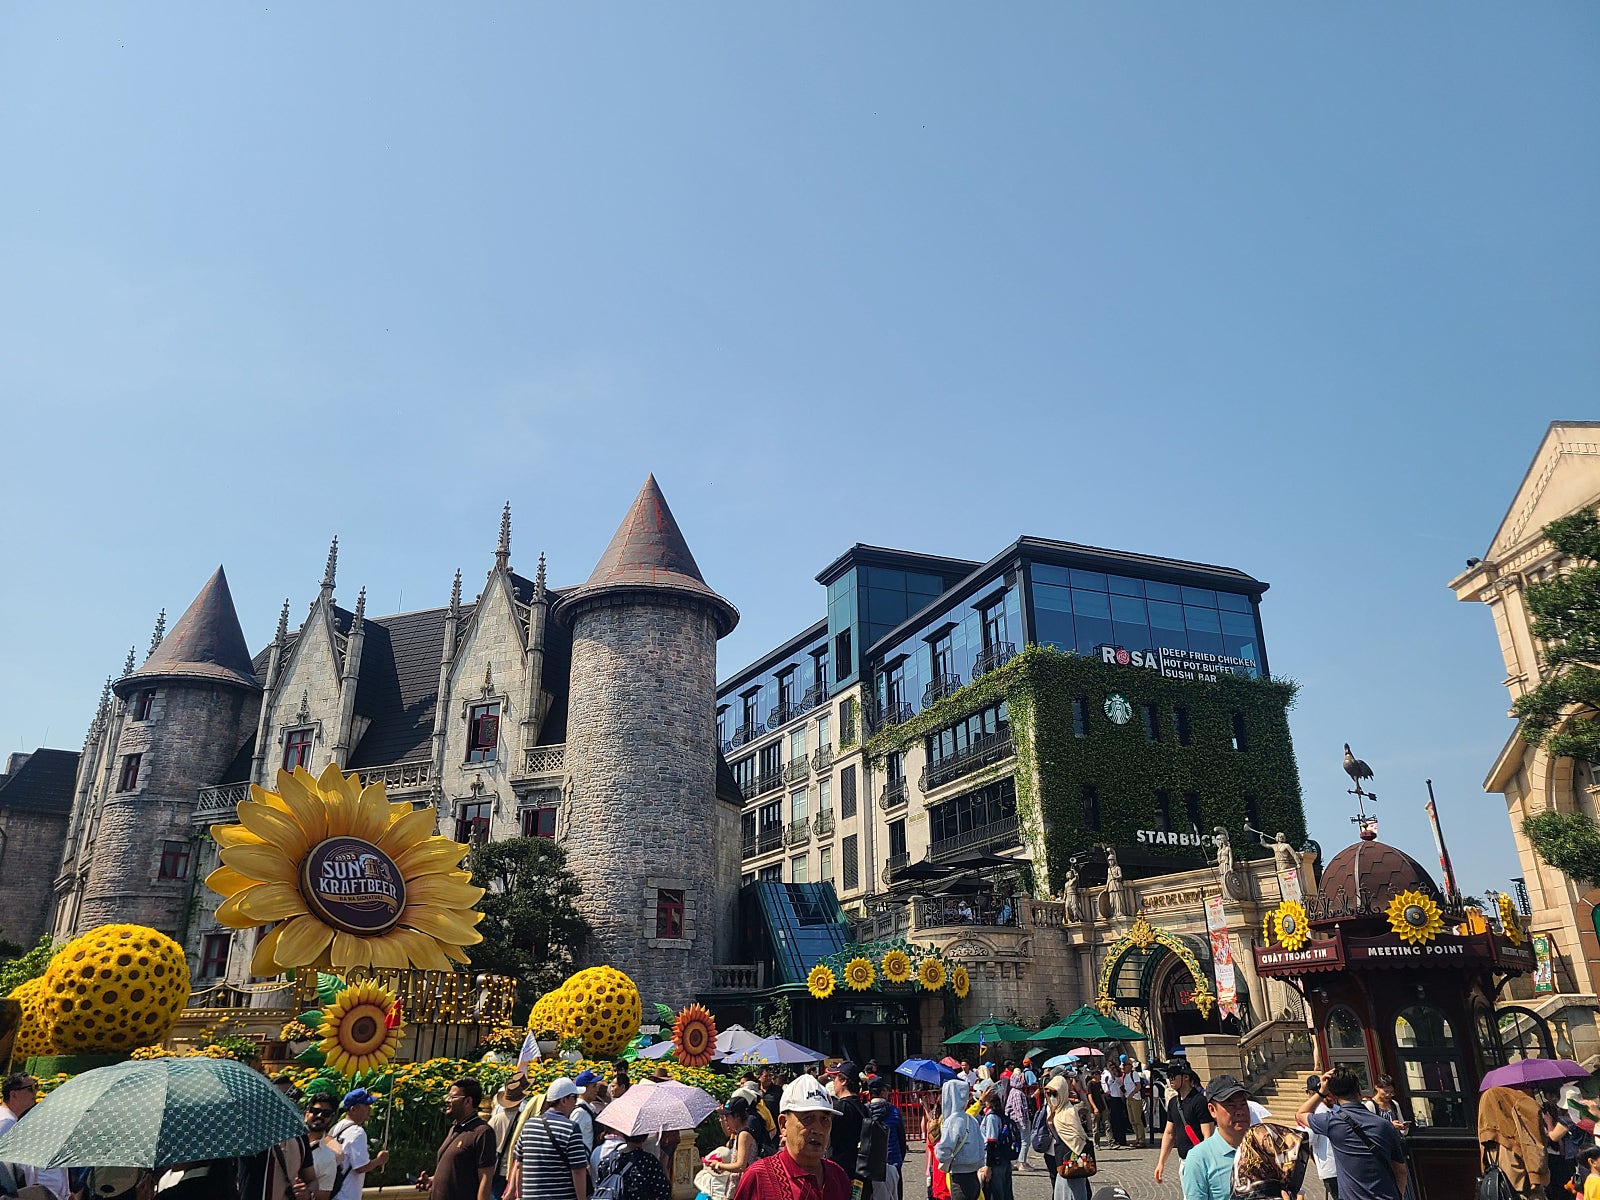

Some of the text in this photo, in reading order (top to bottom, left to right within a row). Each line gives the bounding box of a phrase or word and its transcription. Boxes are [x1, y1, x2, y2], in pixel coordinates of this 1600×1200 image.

[1102, 646, 1158, 670] ROSA
[1162, 647, 1257, 668] DEEP FRIED CHICKEN
[1163, 658, 1235, 675] HOT POT BUFFET
[1165, 668, 1218, 683] SUSHI BAR
[1136, 829, 1218, 847] STARBUC
[322, 860, 362, 879] SUN
[319, 877, 397, 899] KRAFTBEER
[1313, 949, 1327, 959] TIN
[1367, 945, 1464, 956] MEETING POINT
